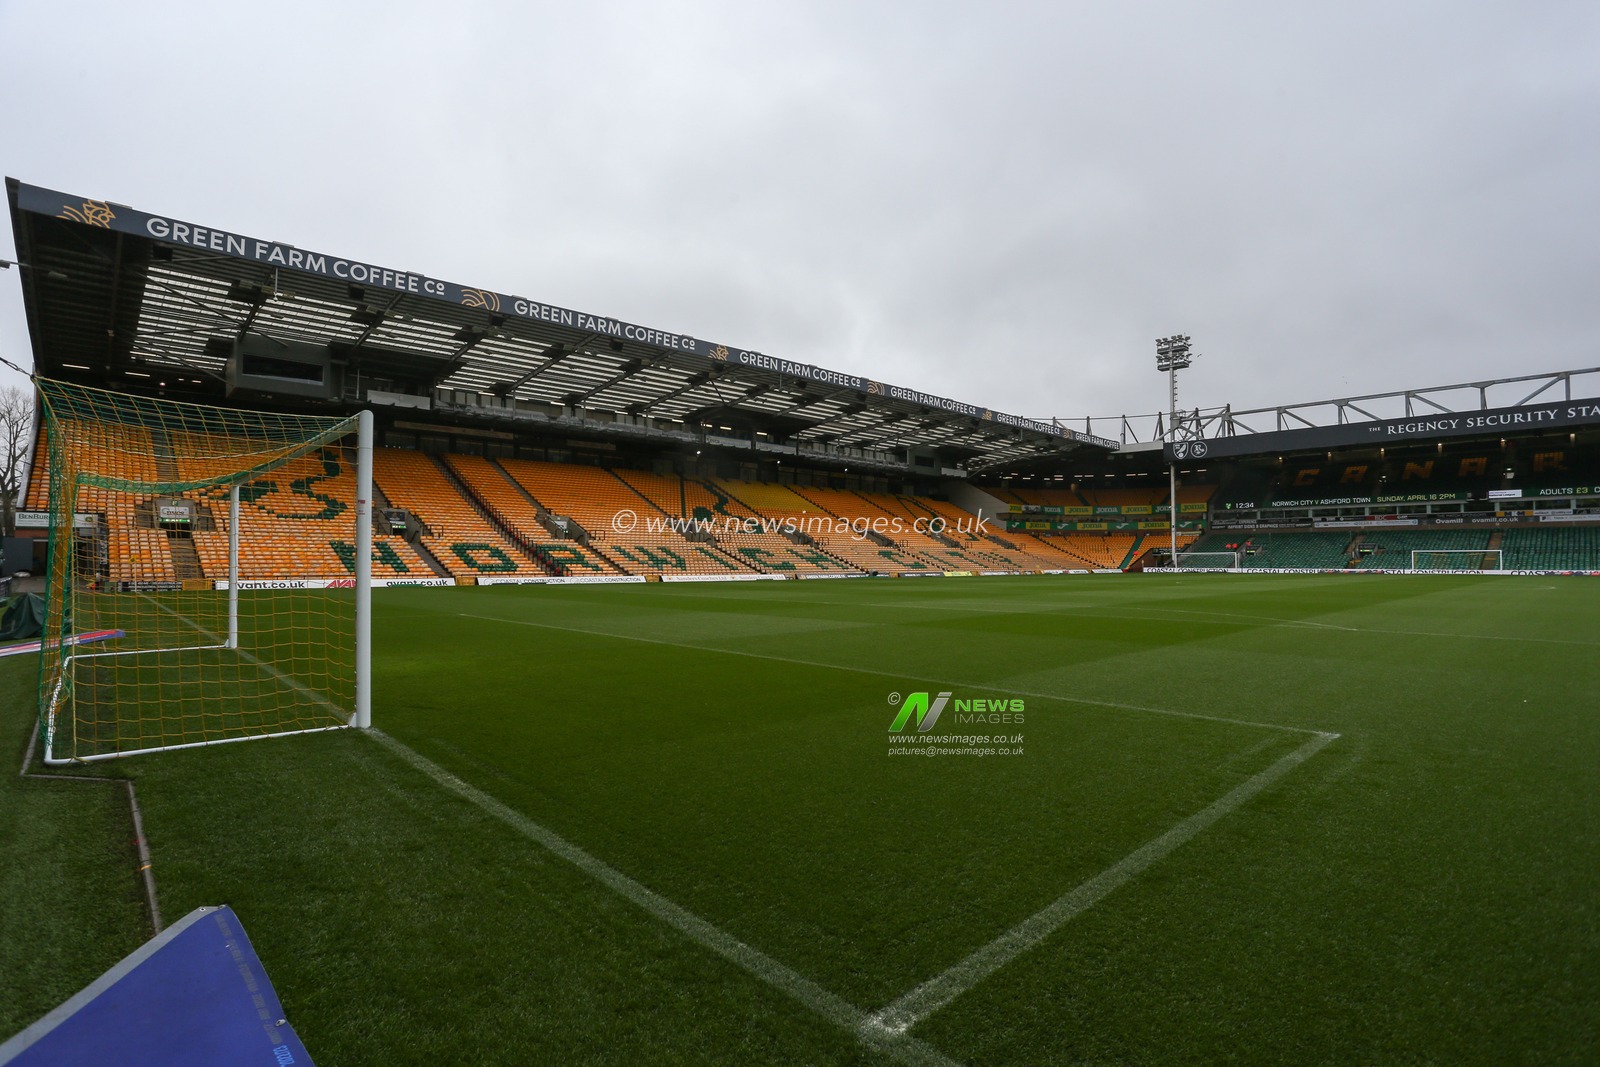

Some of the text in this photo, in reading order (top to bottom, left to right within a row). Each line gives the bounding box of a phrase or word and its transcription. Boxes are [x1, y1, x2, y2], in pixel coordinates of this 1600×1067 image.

[146, 218, 246, 256] GREEN
[255, 242, 327, 274] FARM
[333, 260, 419, 292] COFFEE
[514, 300, 572, 325] GREEN
[577, 314, 621, 336] FARM
[625, 326, 678, 348] COFFEE
[739, 351, 778, 371] GREEN
[781, 361, 811, 378] FARM
[812, 369, 849, 386] COFFEE
[890, 387, 918, 402] GREEN
[919, 394, 940, 407] FARM
[941, 400, 968, 414] COFFEE
[997, 413, 1017, 426] GREEN
[1018, 418, 1035, 430] FARM
[1035, 422, 1054, 434] COFFEE
[1387, 419, 1459, 435] REGENCY
[1466, 409, 1558, 428] SECURITY
[1075, 432, 1120, 450] GREEN FARM COFFEE
